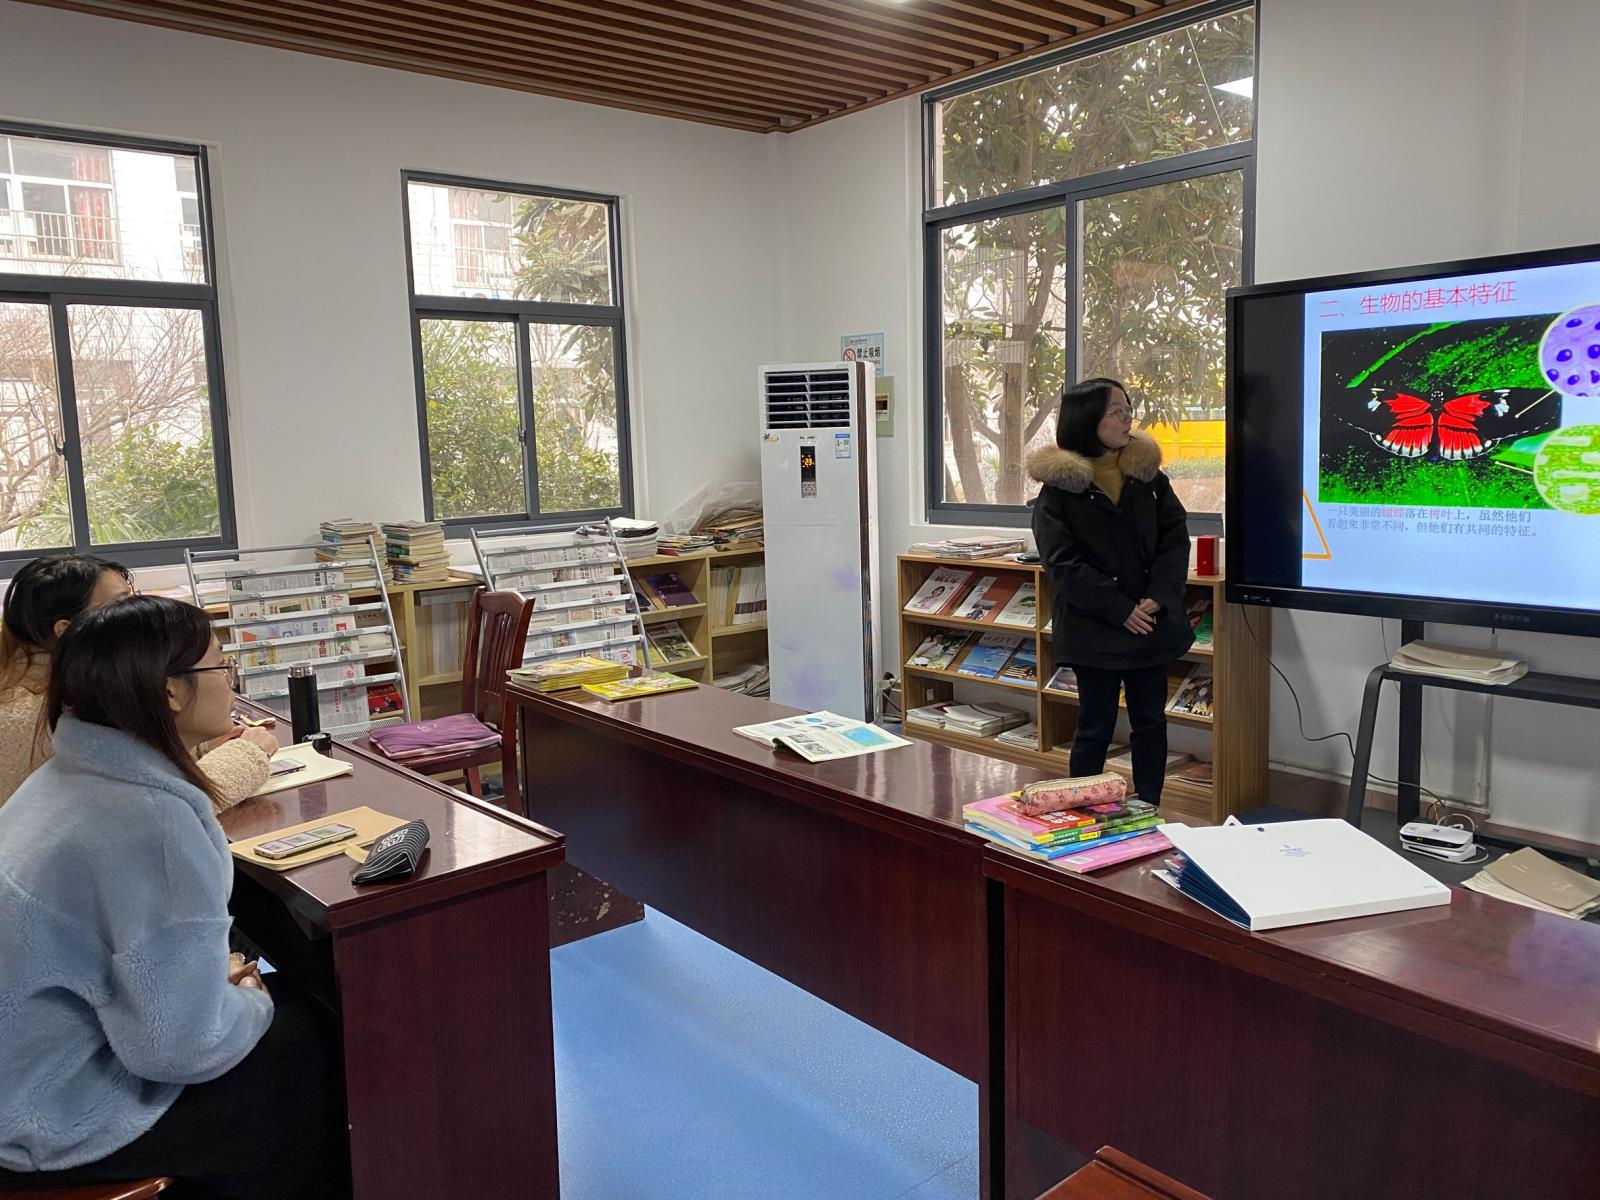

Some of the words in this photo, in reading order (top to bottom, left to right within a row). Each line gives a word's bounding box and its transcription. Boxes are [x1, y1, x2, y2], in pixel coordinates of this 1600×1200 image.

[1319, 281, 1516, 317] 二、生物的基本特征
[857, 347, 880, 359] 禁止吸烟
